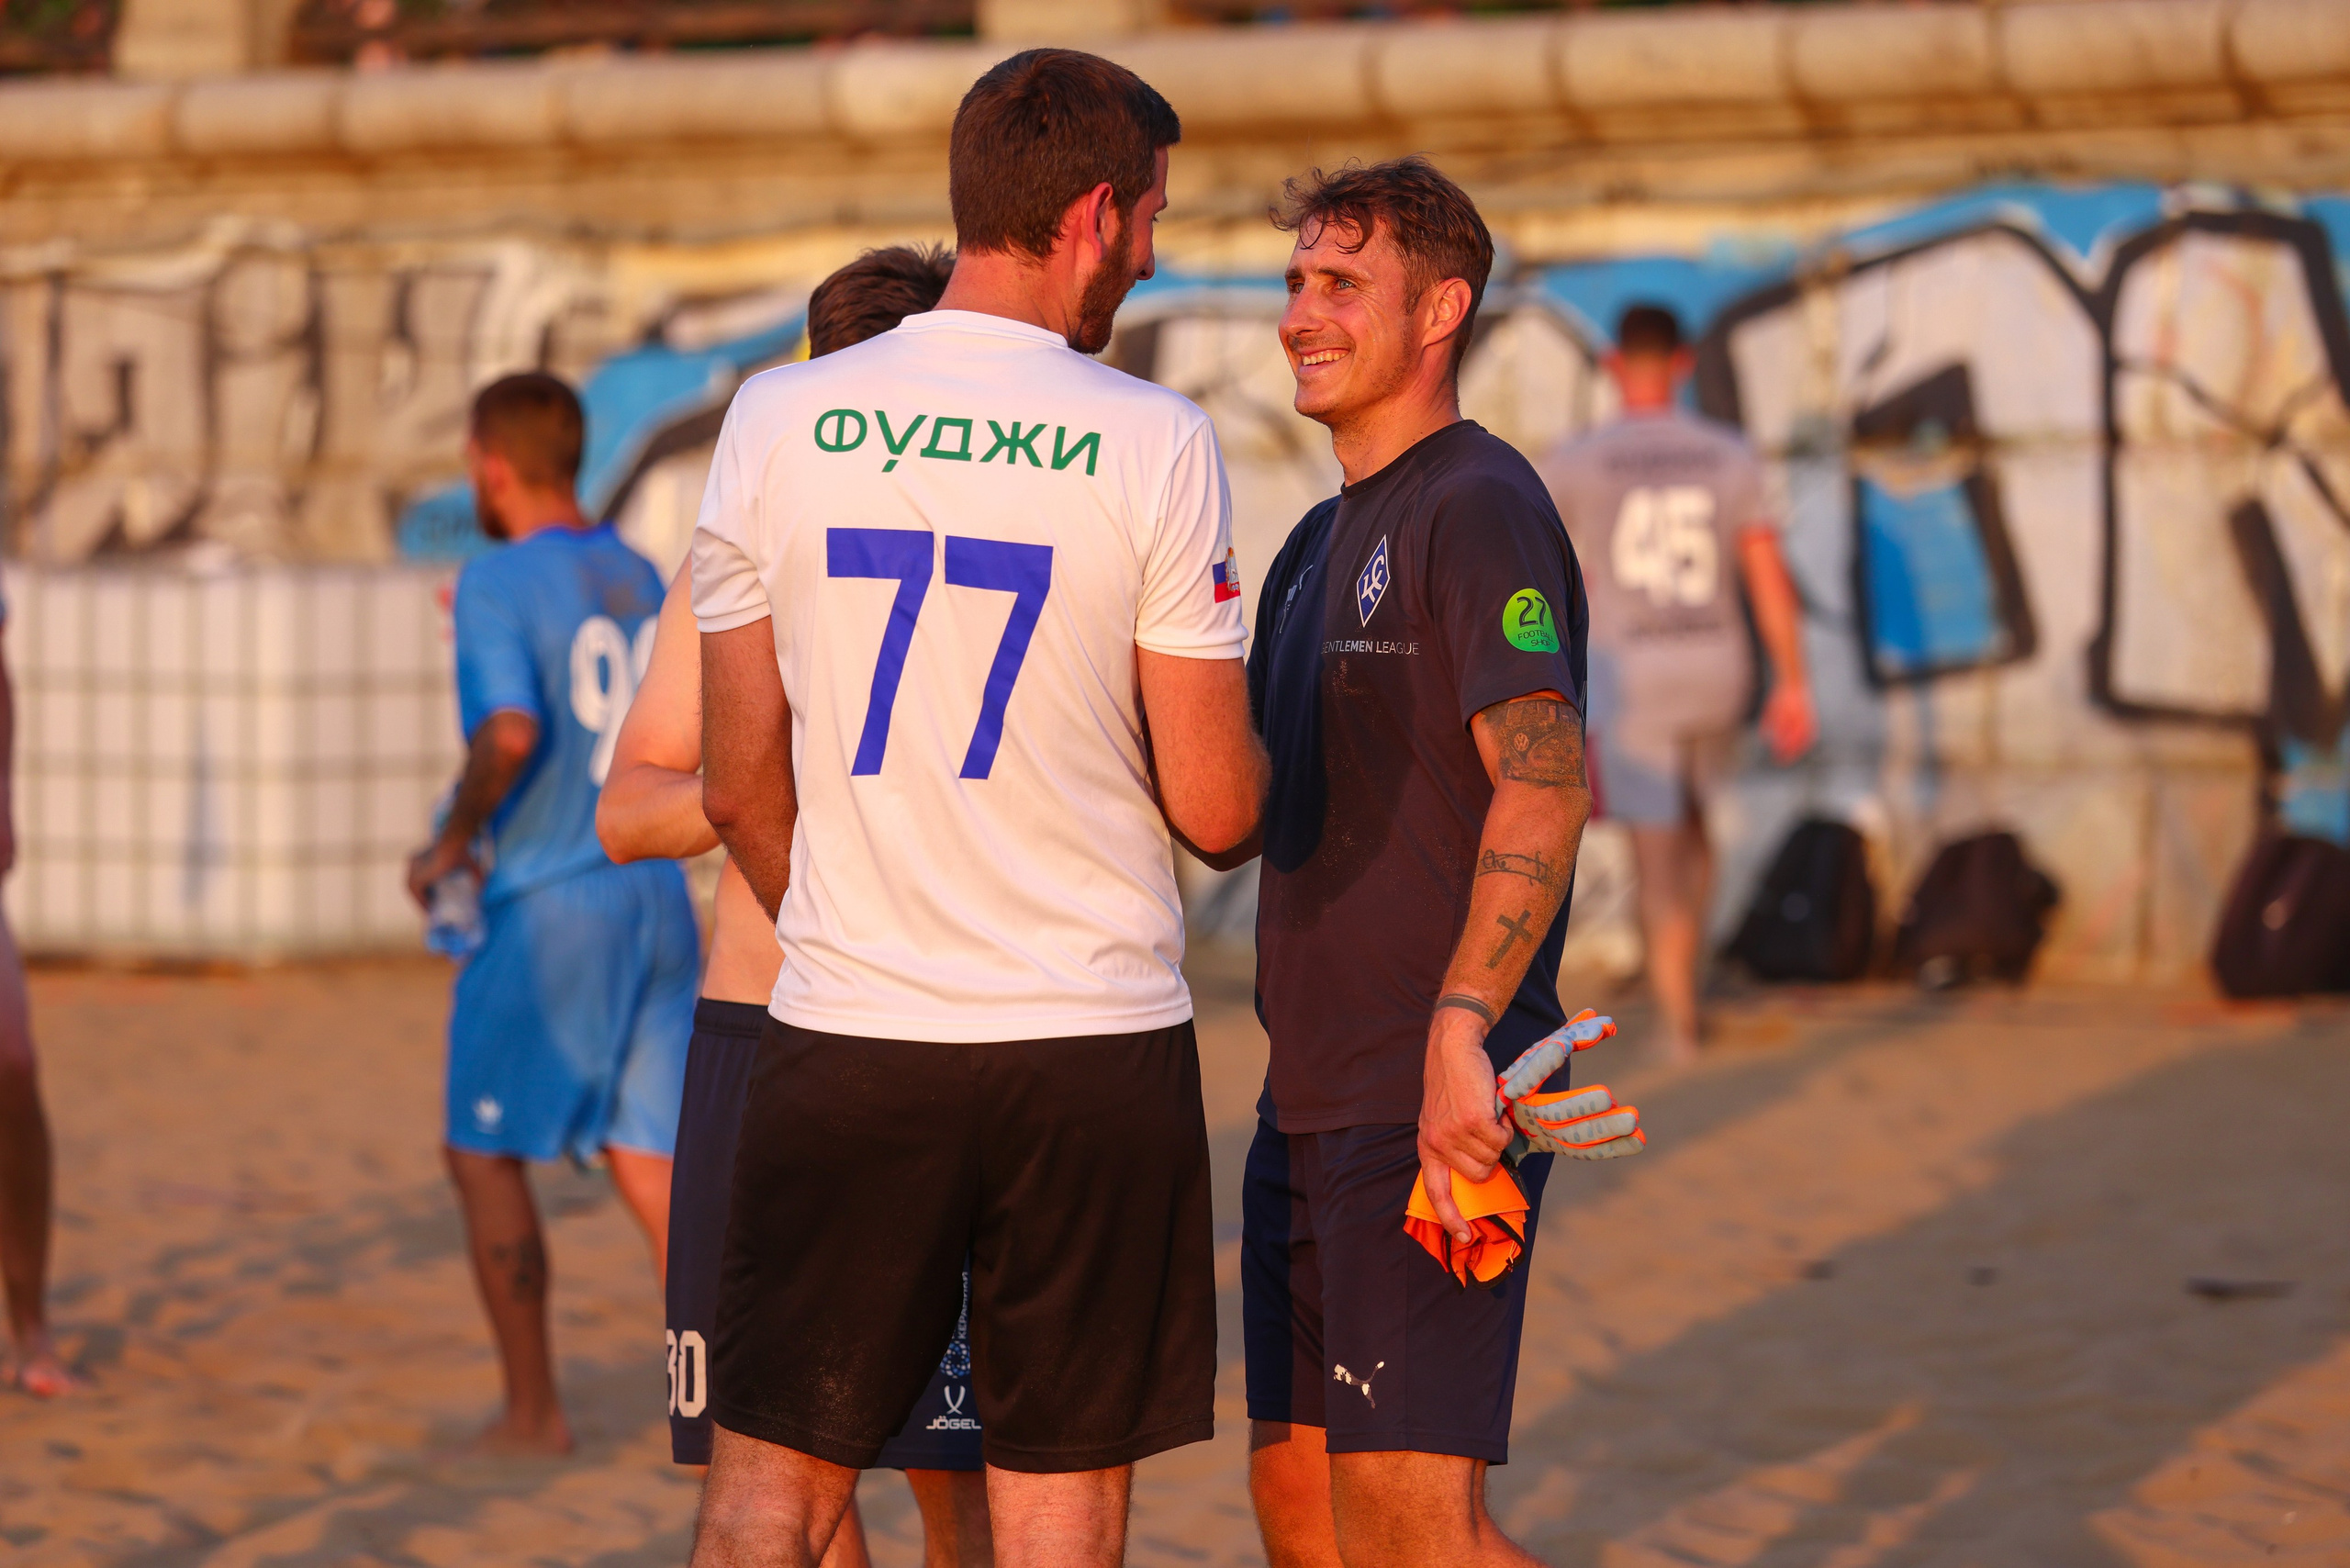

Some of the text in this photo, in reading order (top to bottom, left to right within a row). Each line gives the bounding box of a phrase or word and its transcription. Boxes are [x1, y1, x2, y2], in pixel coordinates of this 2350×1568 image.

[814, 409, 1102, 476] ФУДЖИ
[1610, 484, 1719, 608] 45
[1516, 596, 1546, 628] 27
[826, 527, 1054, 779] 77
[1376, 641, 1420, 655] LEAGUE
[569, 613, 660, 788] 9
[925, 1415, 982, 1429] JÖGEL
